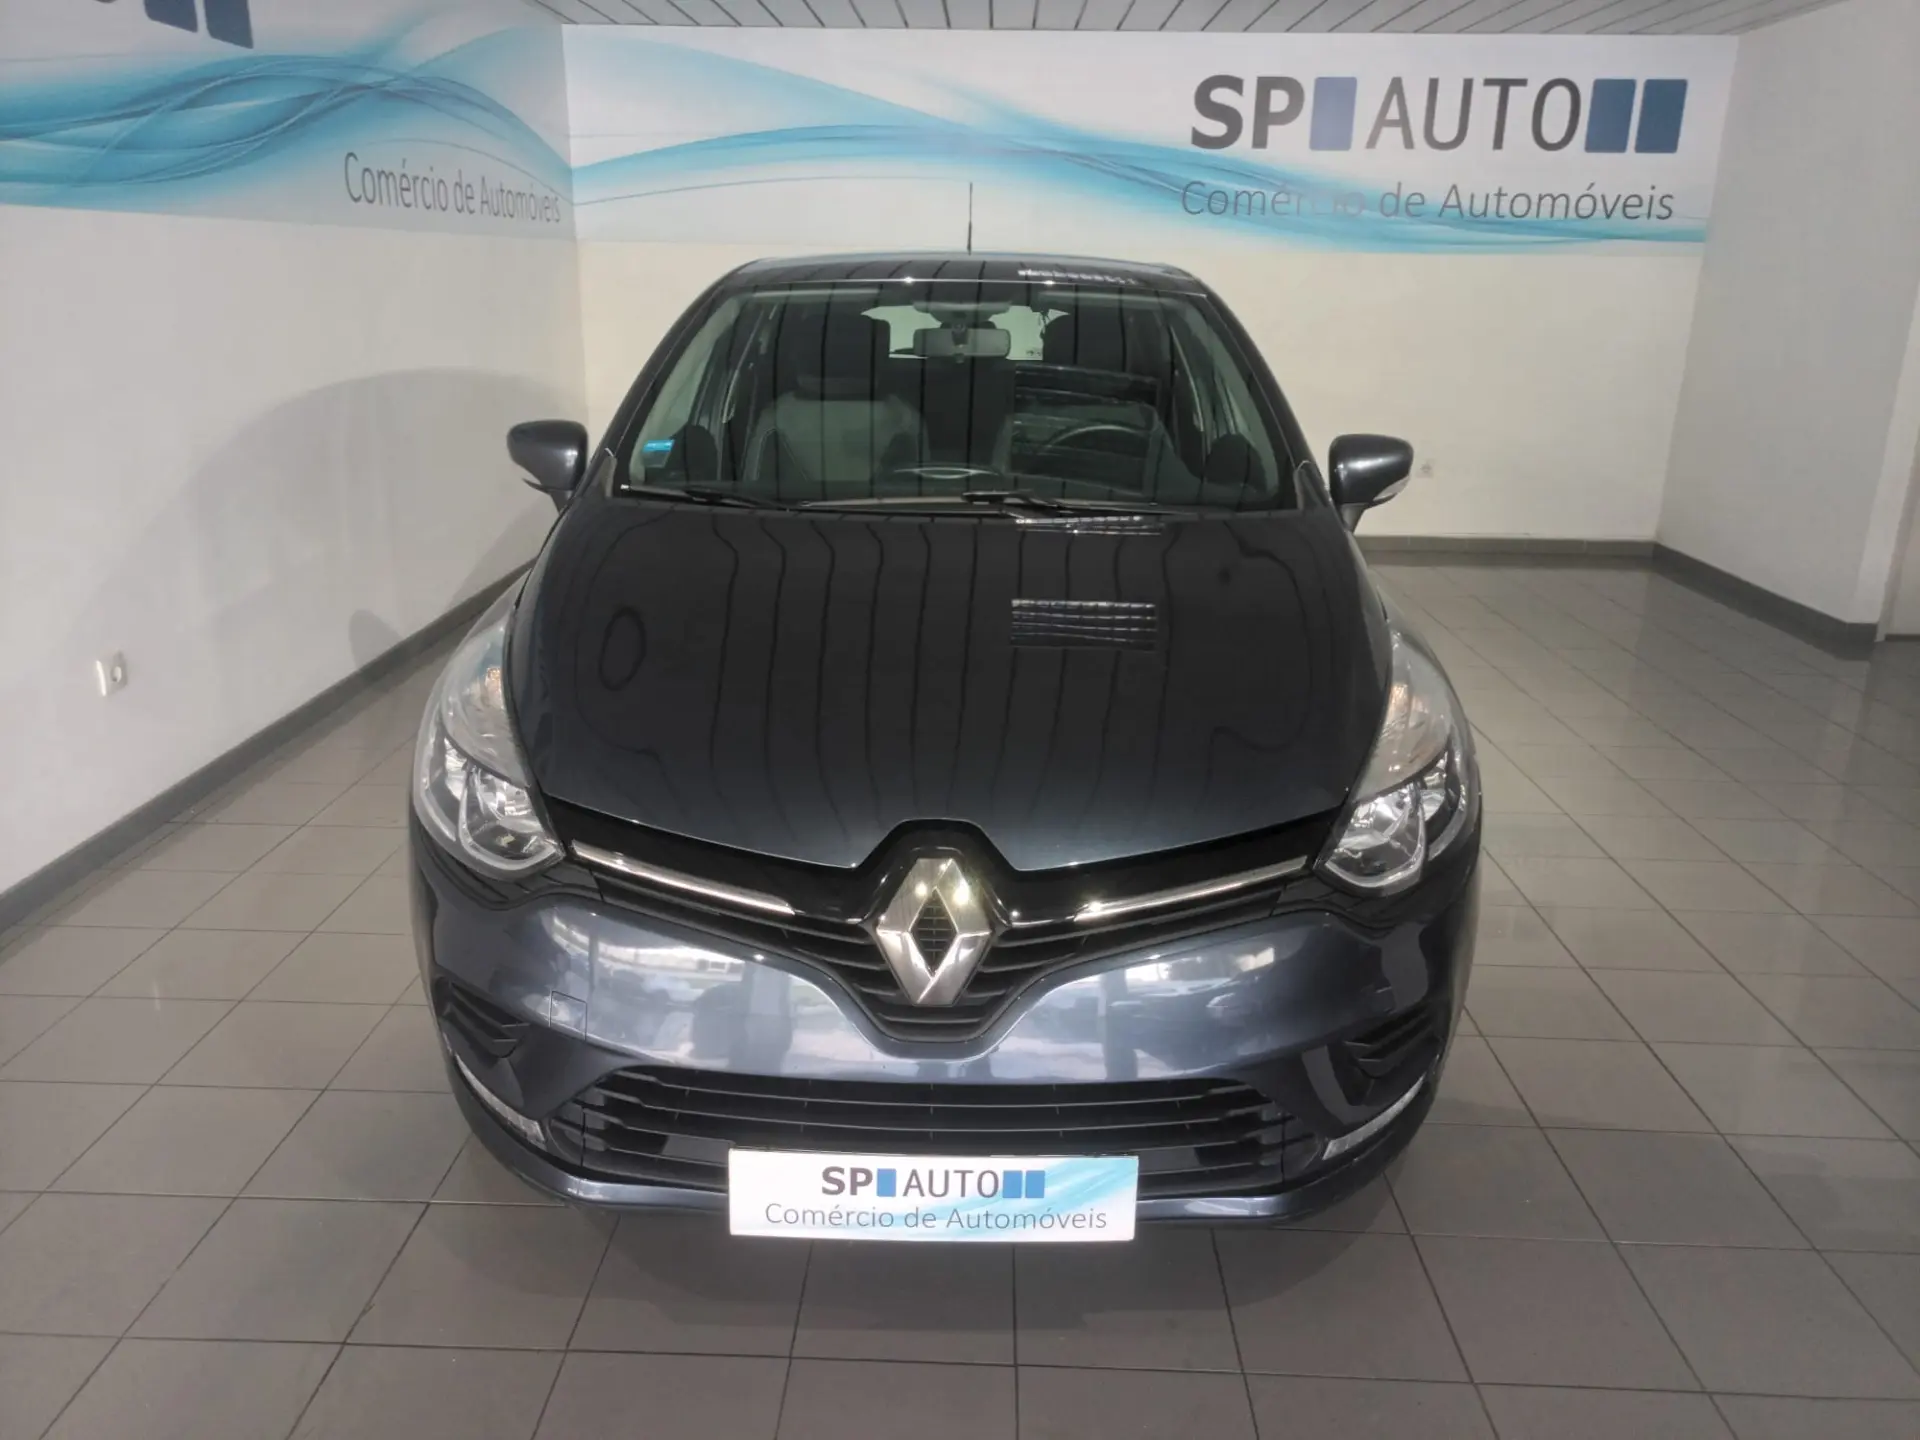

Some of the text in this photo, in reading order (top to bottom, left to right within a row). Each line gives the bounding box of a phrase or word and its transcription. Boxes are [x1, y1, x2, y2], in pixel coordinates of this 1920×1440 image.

[1190, 74, 1582, 151] SP AUTO
[344, 152, 561, 222] Comércio de Automóveis
[1380, 182, 1426, 218] de
[1437, 183, 1673, 220] Automóveis
[821, 1166, 999, 1198] SP AUTO
[765, 1203, 1106, 1229] Comércio de Automóveis
